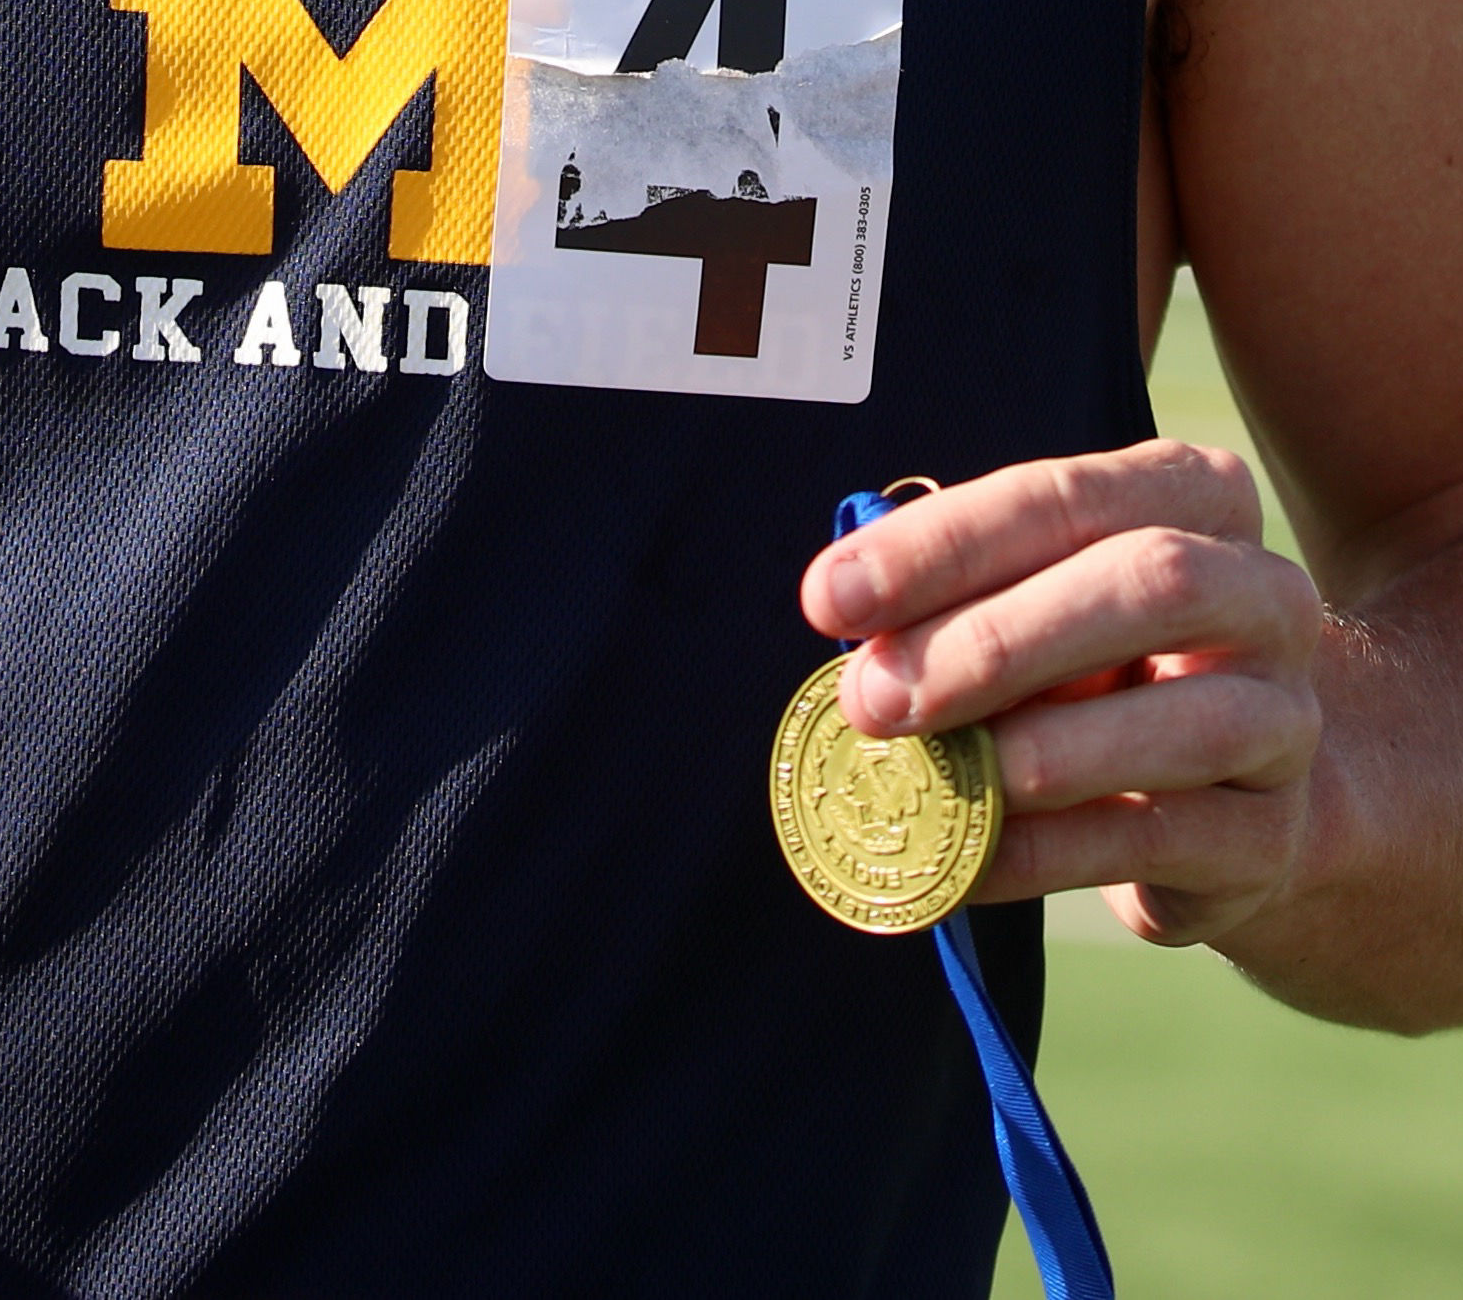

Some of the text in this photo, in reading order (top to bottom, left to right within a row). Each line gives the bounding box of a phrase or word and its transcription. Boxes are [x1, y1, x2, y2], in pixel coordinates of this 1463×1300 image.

[234, 281, 469, 377] AND
[843, 186, 871, 361] VS ATHLETICS (800) 383-0305
